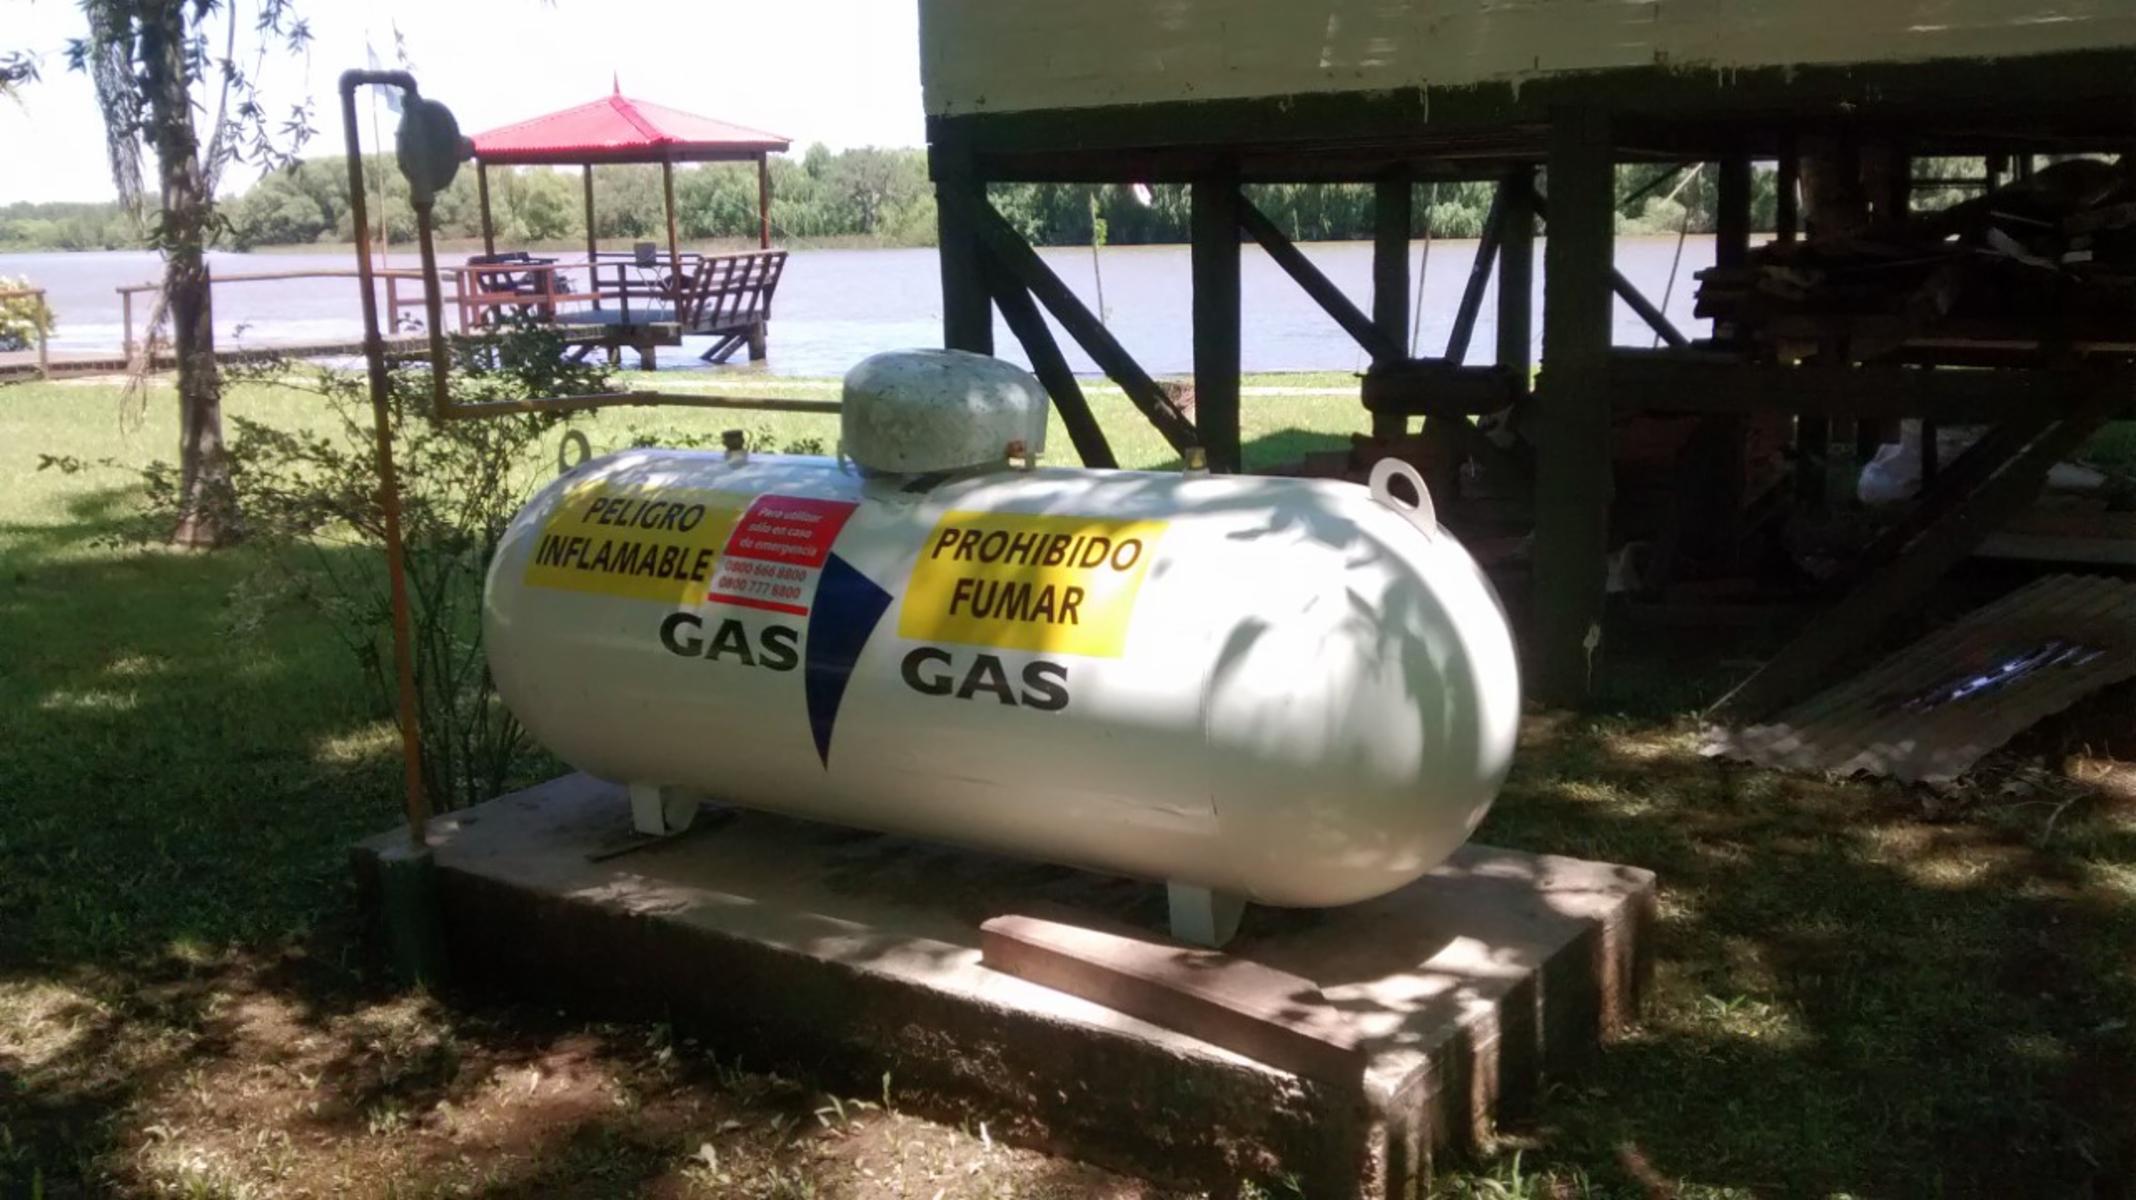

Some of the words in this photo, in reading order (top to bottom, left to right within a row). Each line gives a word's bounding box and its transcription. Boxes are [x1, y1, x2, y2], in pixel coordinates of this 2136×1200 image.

[582, 497, 705, 532] PELIGRO
[758, 507, 783, 519] Para
[784, 510, 823, 523] utilizar
[772, 526, 787, 535] en
[787, 528, 812, 538] caso
[536, 534, 713, 582] INFLAMABLE
[739, 537, 754, 548] de
[755, 540, 817, 557] emergencia
[931, 528, 1142, 572] PROHIBIDO
[748, 579, 770, 594] 777
[949, 577, 1084, 625] FUMAR
[660, 612, 798, 672] GAS
[901, 646, 1069, 711] GAS
